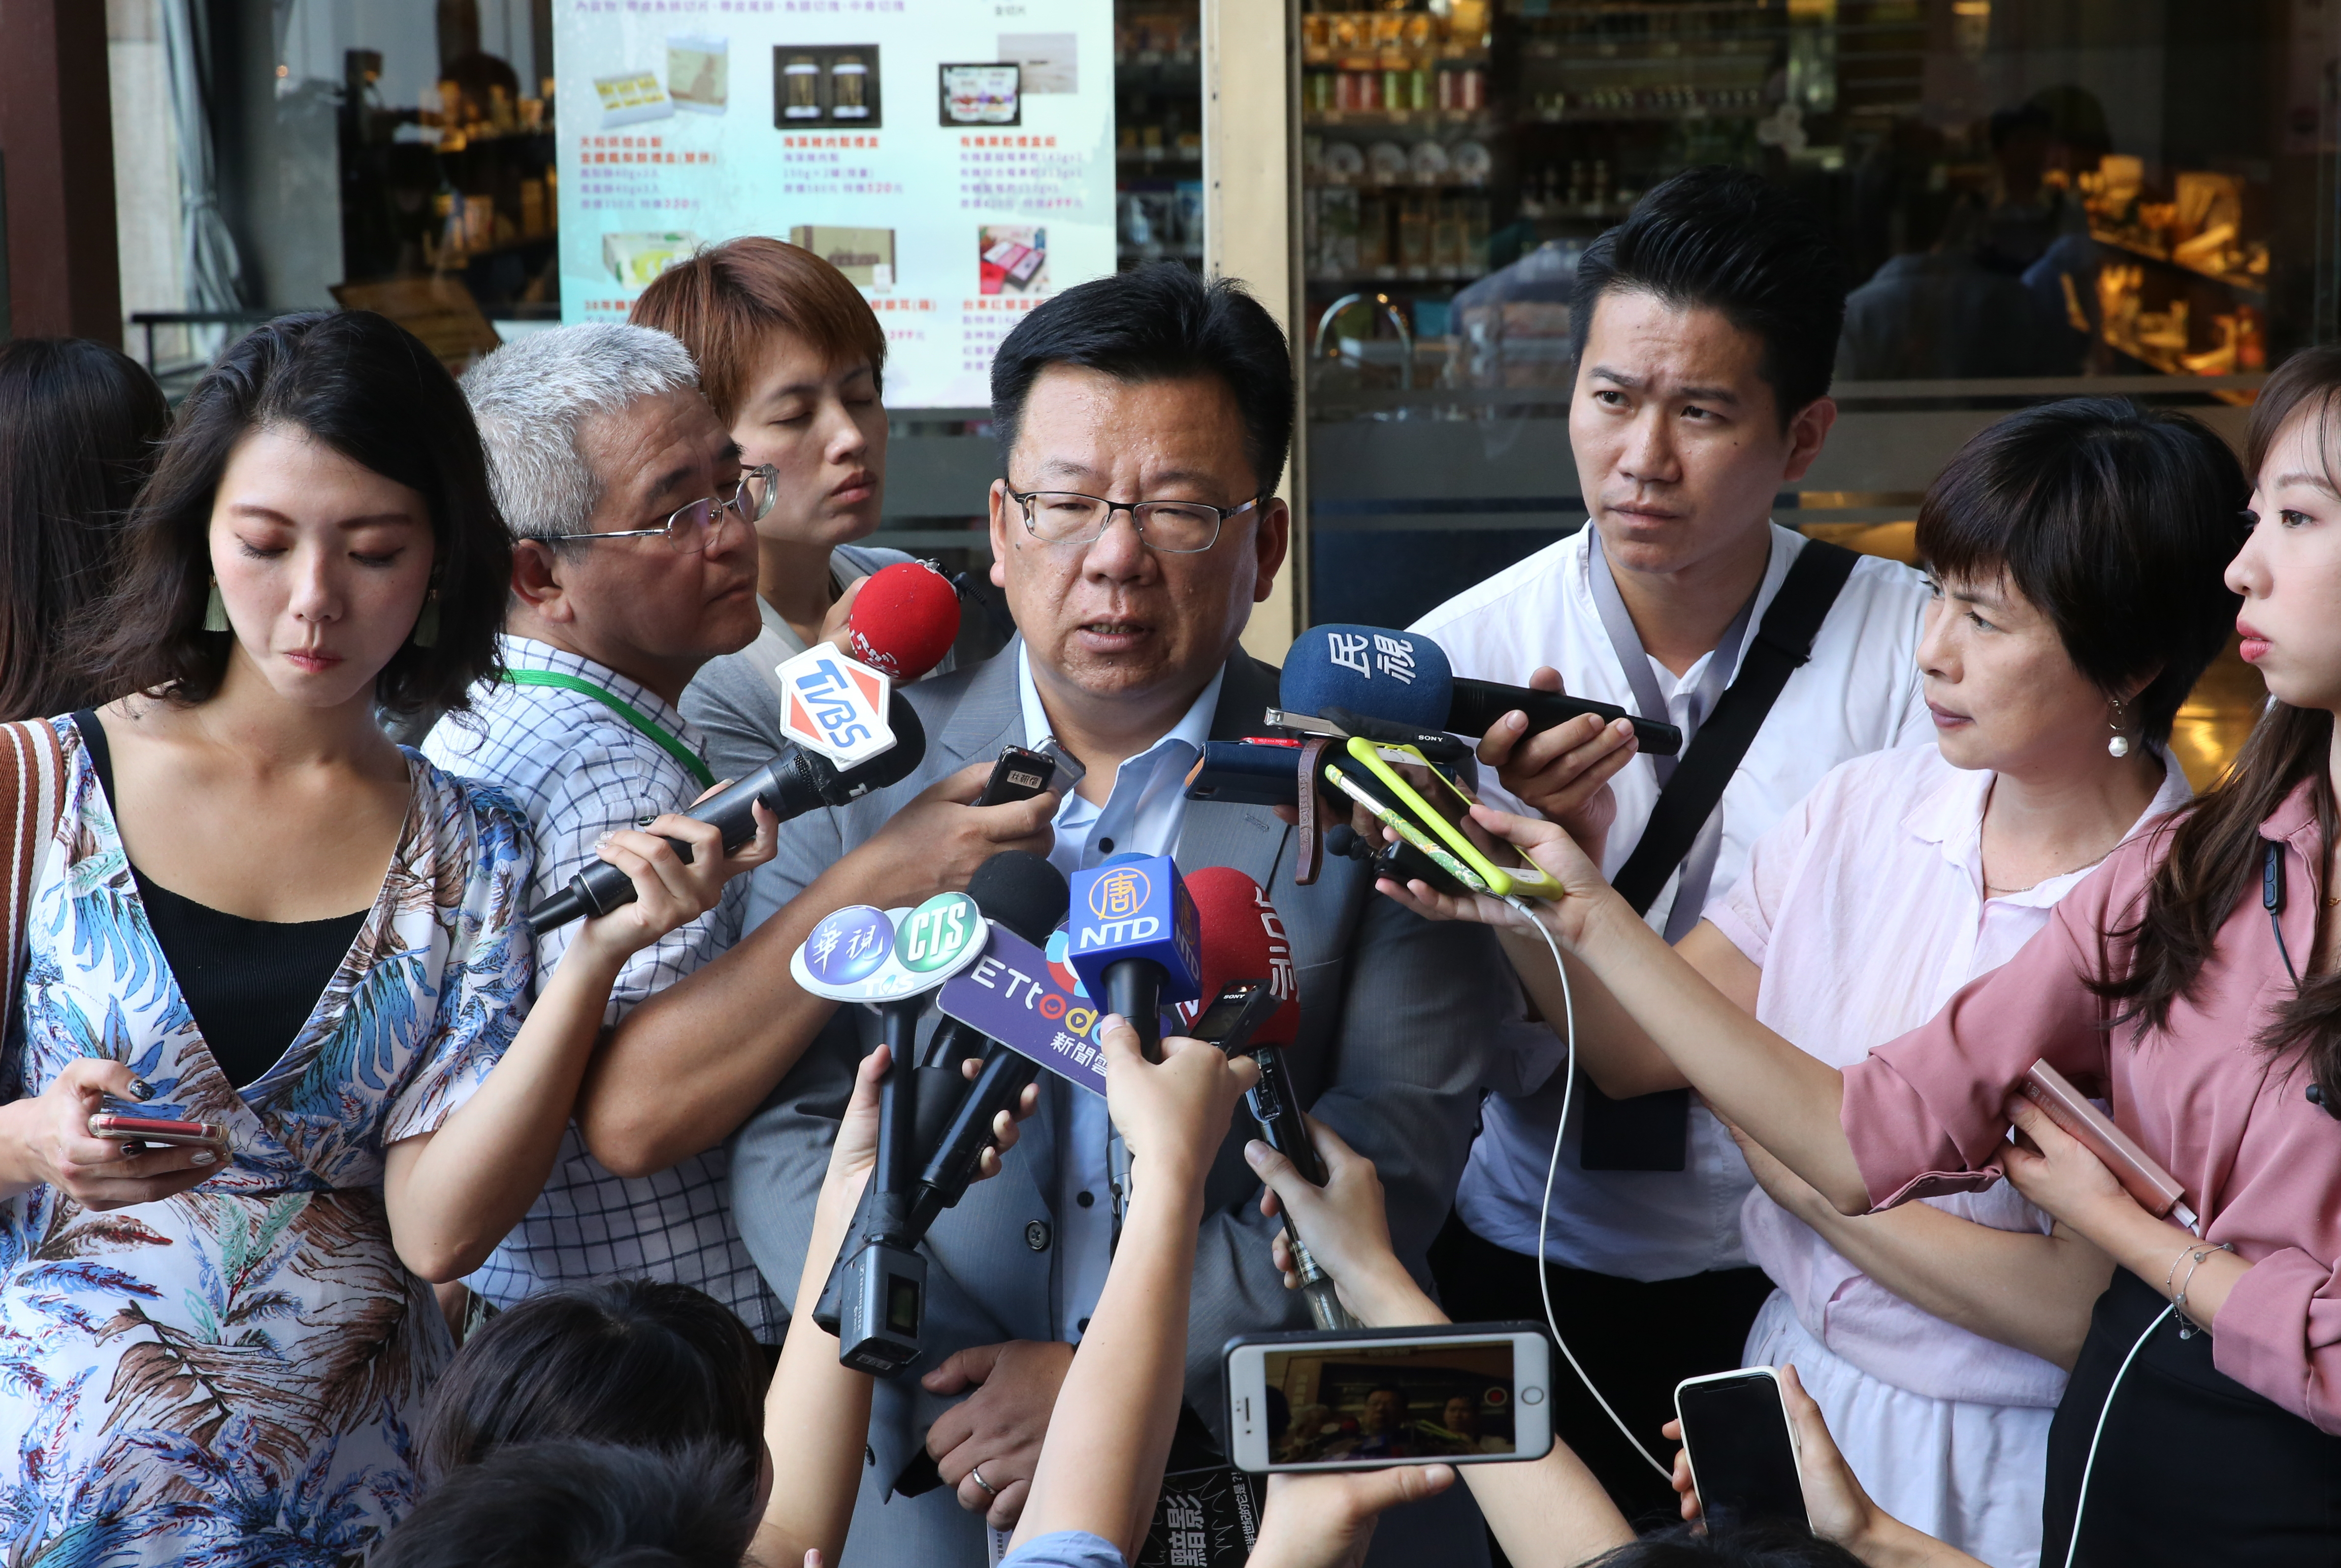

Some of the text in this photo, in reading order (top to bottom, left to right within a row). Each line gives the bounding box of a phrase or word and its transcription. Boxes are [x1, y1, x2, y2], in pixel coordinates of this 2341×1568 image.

[1328, 633, 1417, 685] 民視
[796, 660, 871, 747] TVBS
[813, 922, 883, 975] 華視
[908, 901, 967, 961] CTS
[1079, 916, 1159, 949] NTD
[1176, 923, 1200, 981] NTD
[1166, 1493, 1208, 1567] 黯影
